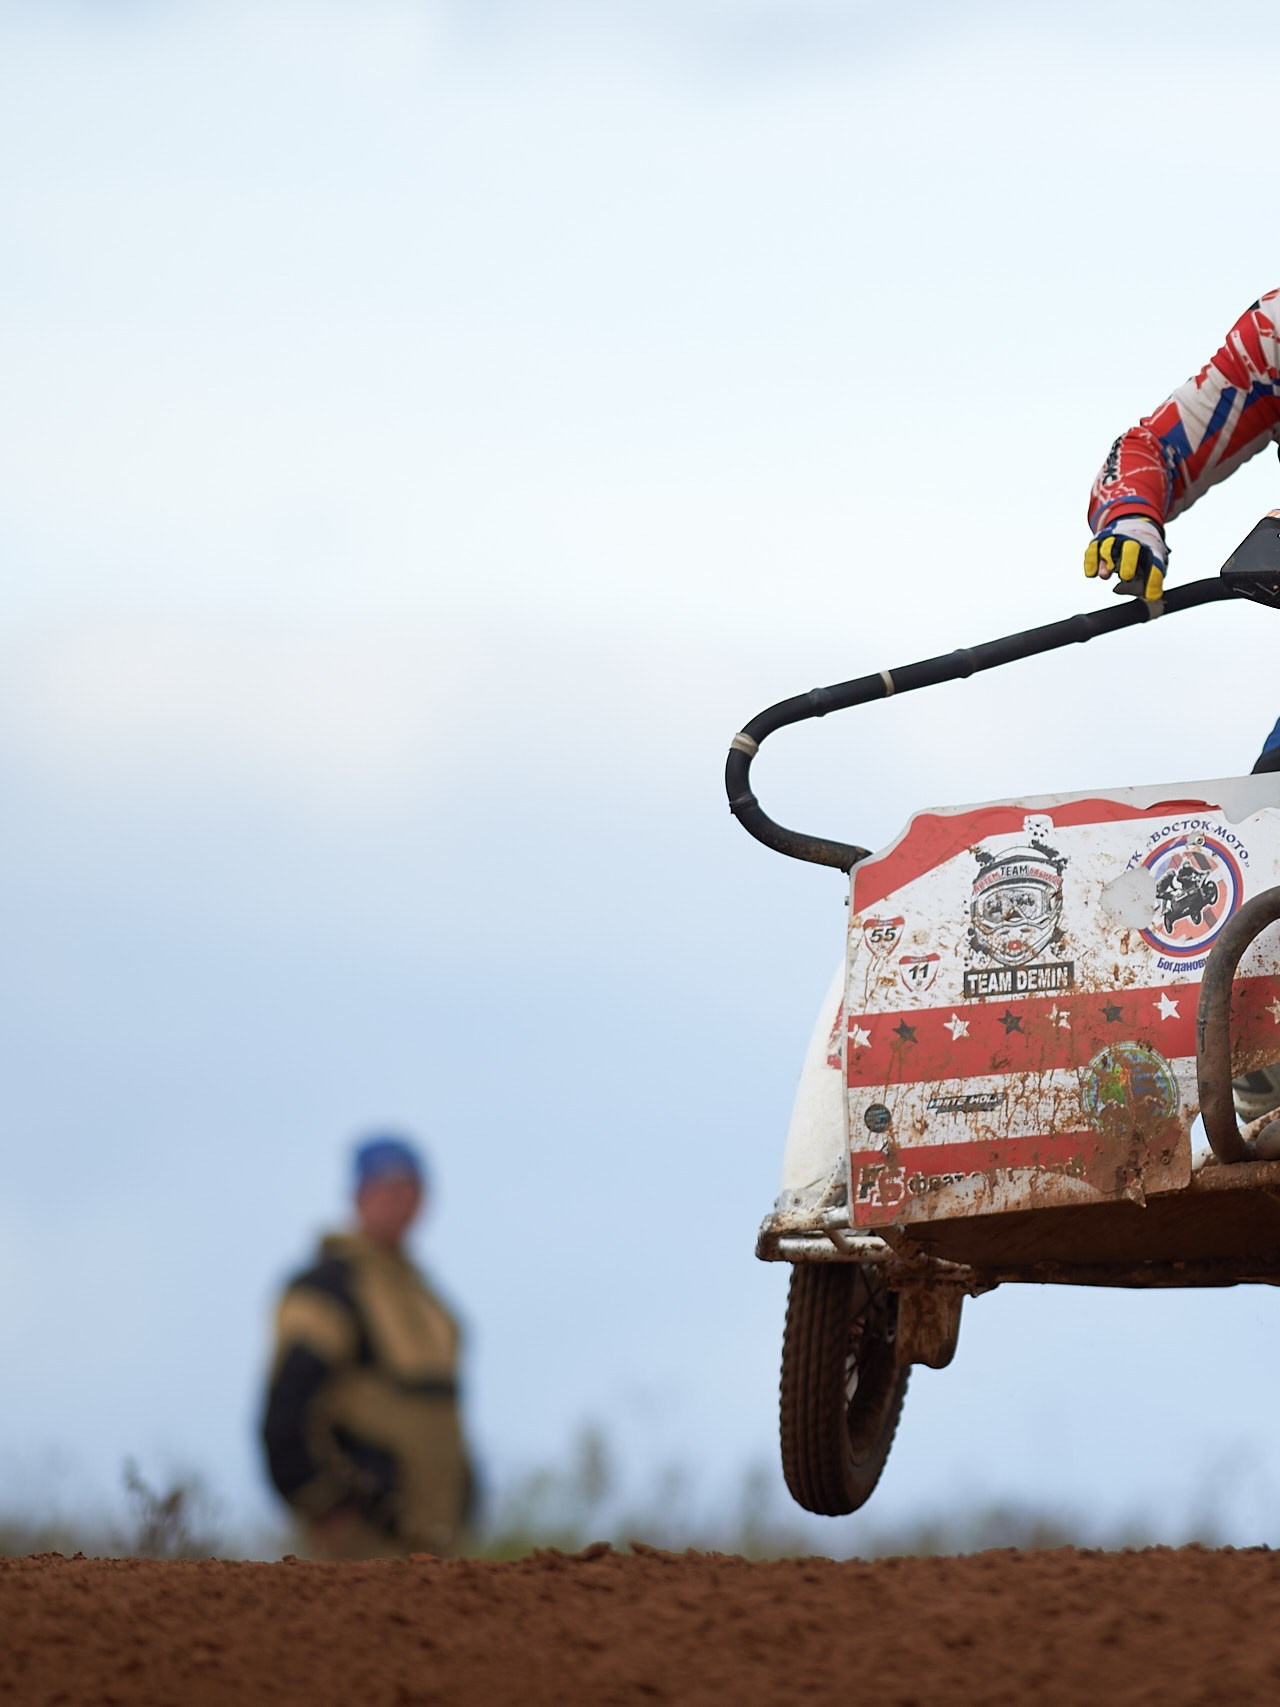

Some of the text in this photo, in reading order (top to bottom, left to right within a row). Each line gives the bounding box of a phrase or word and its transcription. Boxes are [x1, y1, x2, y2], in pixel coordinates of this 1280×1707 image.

[1000, 865, 1028, 877] TEAM
[870, 927, 897, 943] 55
[909, 964, 929, 980] 11
[1157, 957, 1209, 973] Богданов
[967, 966, 1068, 994] TEAM DEMIN
